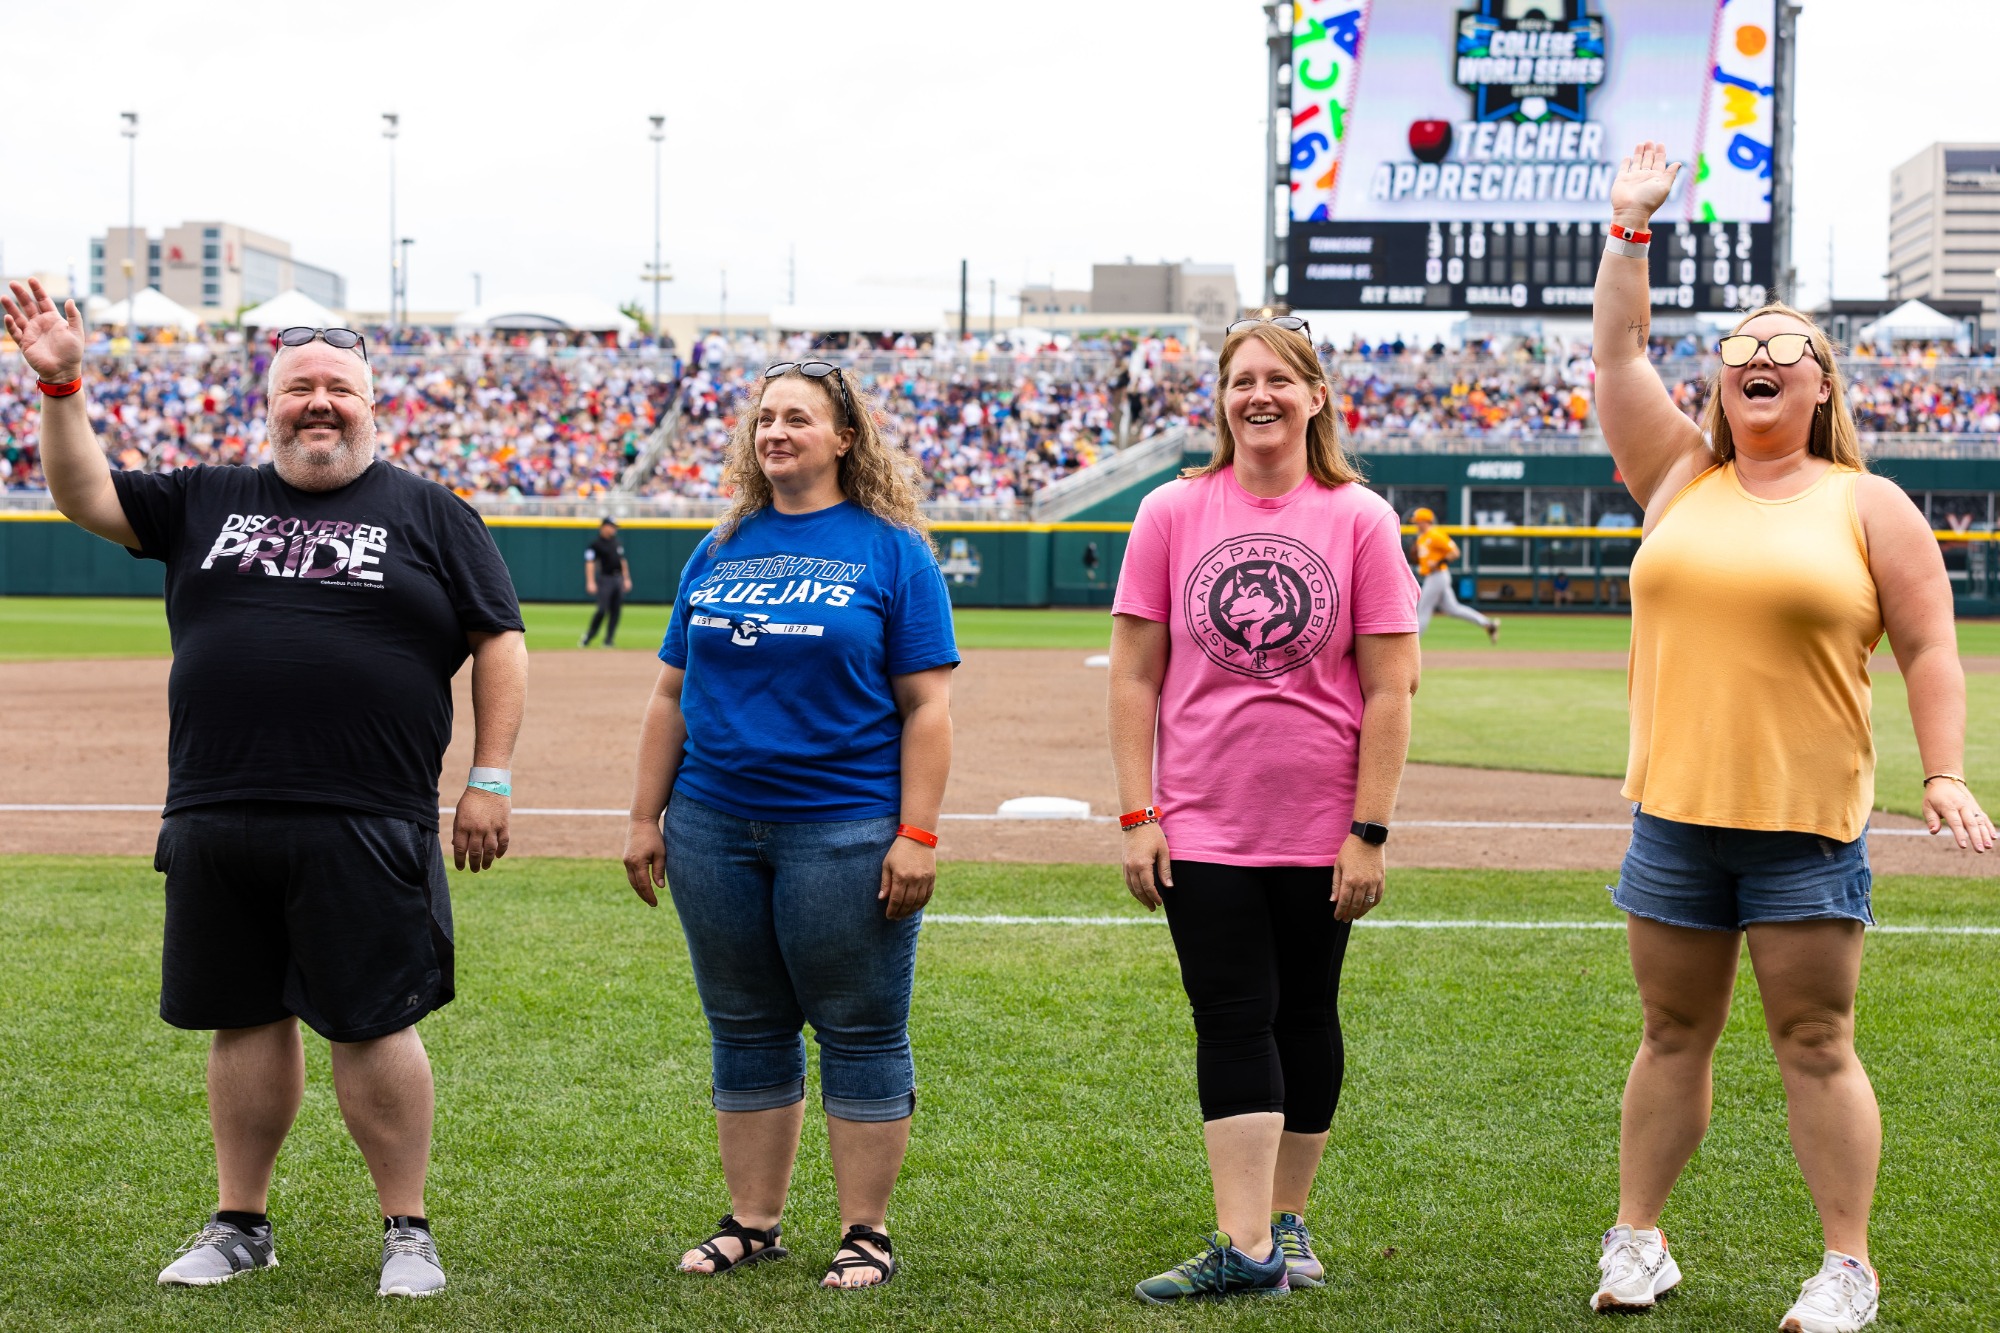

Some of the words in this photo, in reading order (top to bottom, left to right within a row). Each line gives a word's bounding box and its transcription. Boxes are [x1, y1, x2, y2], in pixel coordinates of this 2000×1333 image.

[1489, 30, 1577, 58] COLLEGE
[1458, 57, 1533, 84] WORLD
[1533, 57, 1604, 84] SERIES
[1457, 121, 1604, 161] TEACHER
[1371, 162, 1613, 201] APPRECIATION
[1469, 232, 1486, 259] 0
[1680, 234, 1697, 258] 4
[1713, 232, 1730, 259] 5
[1735, 232, 1752, 259] 2
[1426, 258, 1443, 285] 0
[1447, 258, 1464, 285] 0
[1679, 258, 1696, 285] 0
[1713, 258, 1730, 285] 0
[1360, 285, 1386, 304] AT
[1387, 285, 1426, 304] BAT
[1465, 286, 1512, 305] BALL
[1511, 283, 1528, 308] 0
[1677, 284, 1694, 309] 0
[221, 513, 388, 547] DISCOVERER
[200, 531, 388, 582] PRIDE
[700, 554, 867, 588] CREIGHTON
[689, 579, 856, 607] BLUEJAYS
[1195, 561, 1240, 659] ASHLAND
[783, 625, 809, 634] 1878
